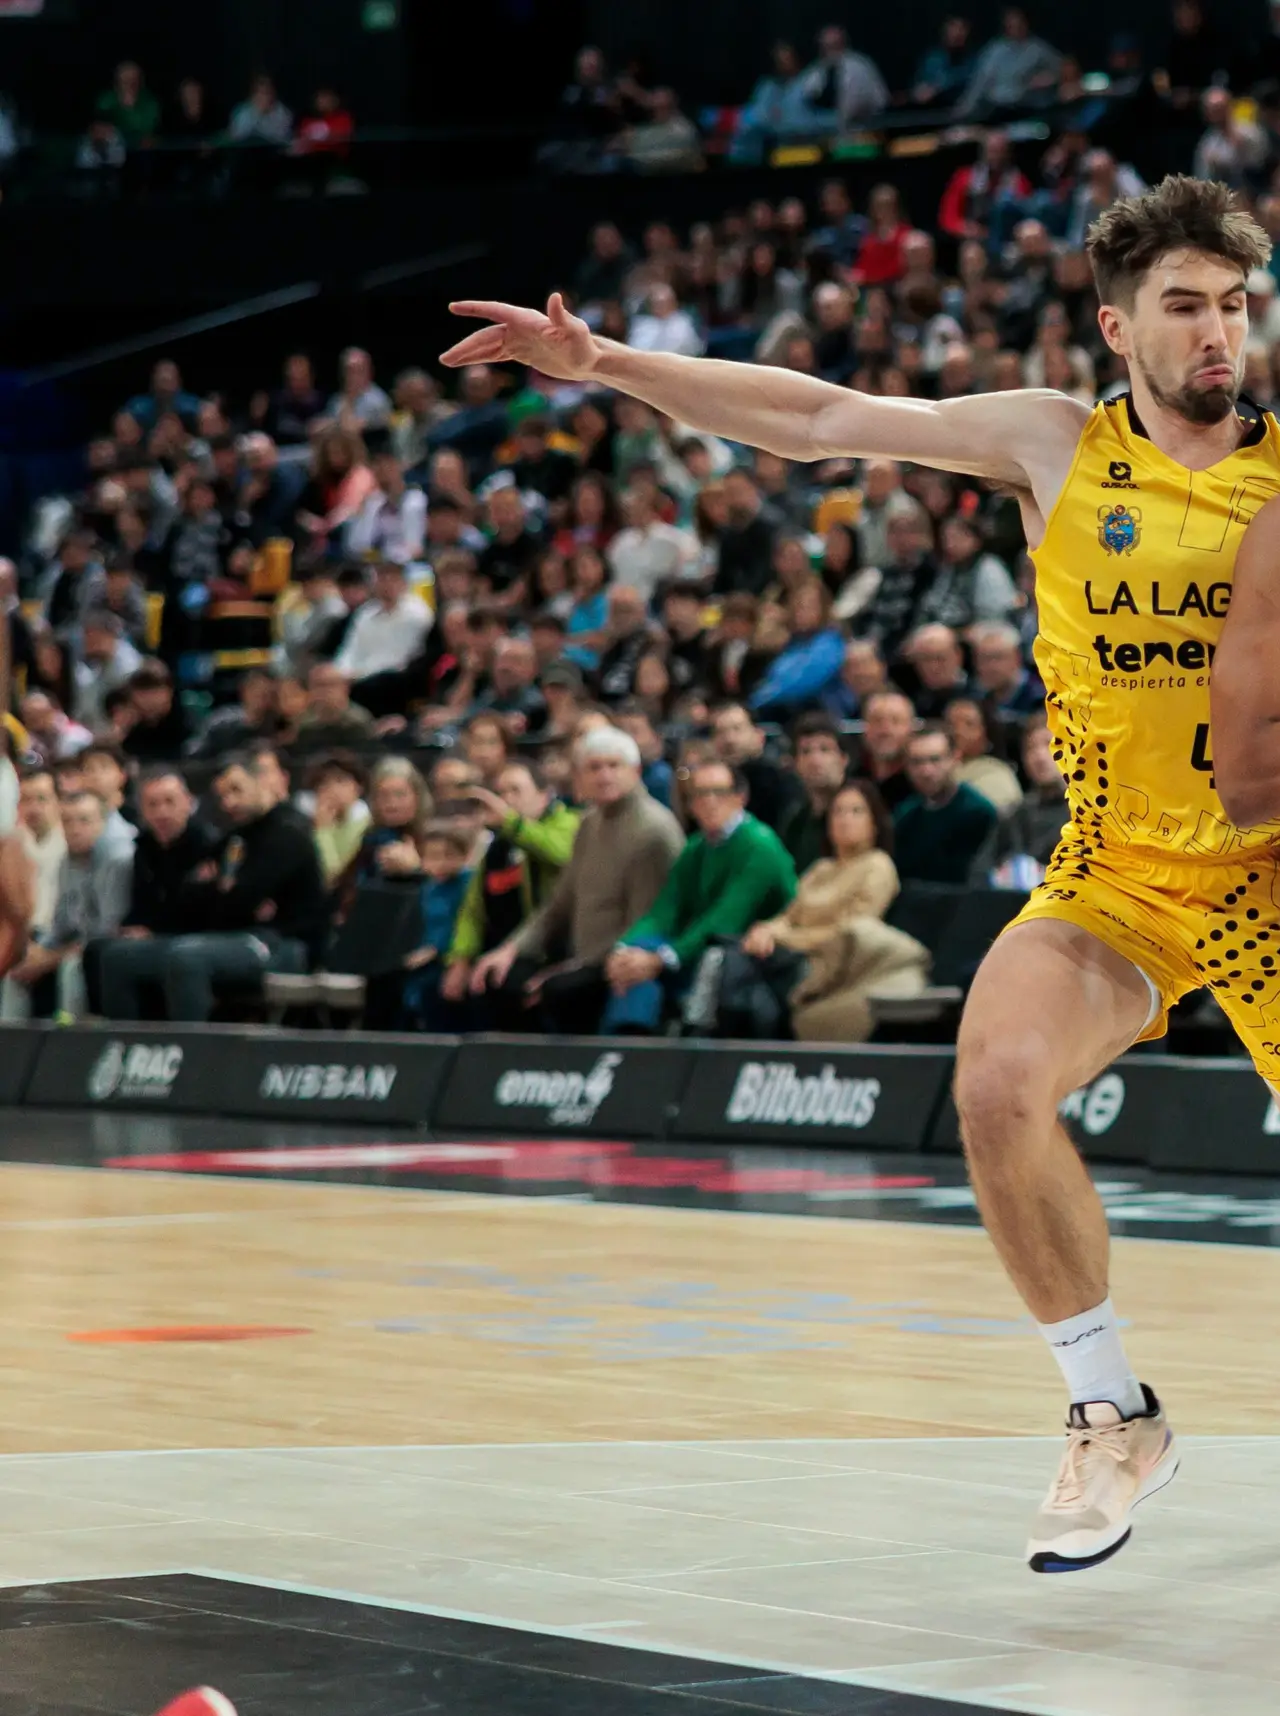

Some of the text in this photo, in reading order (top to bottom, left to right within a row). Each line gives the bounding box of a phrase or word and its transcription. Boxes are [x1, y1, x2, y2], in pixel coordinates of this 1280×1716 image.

[1085, 580, 1233, 618] LA LAG
[1101, 674, 1186, 690] despierta
[262, 1063, 398, 1100] NISSAN
[726, 1062, 881, 1127] Bilbobus
